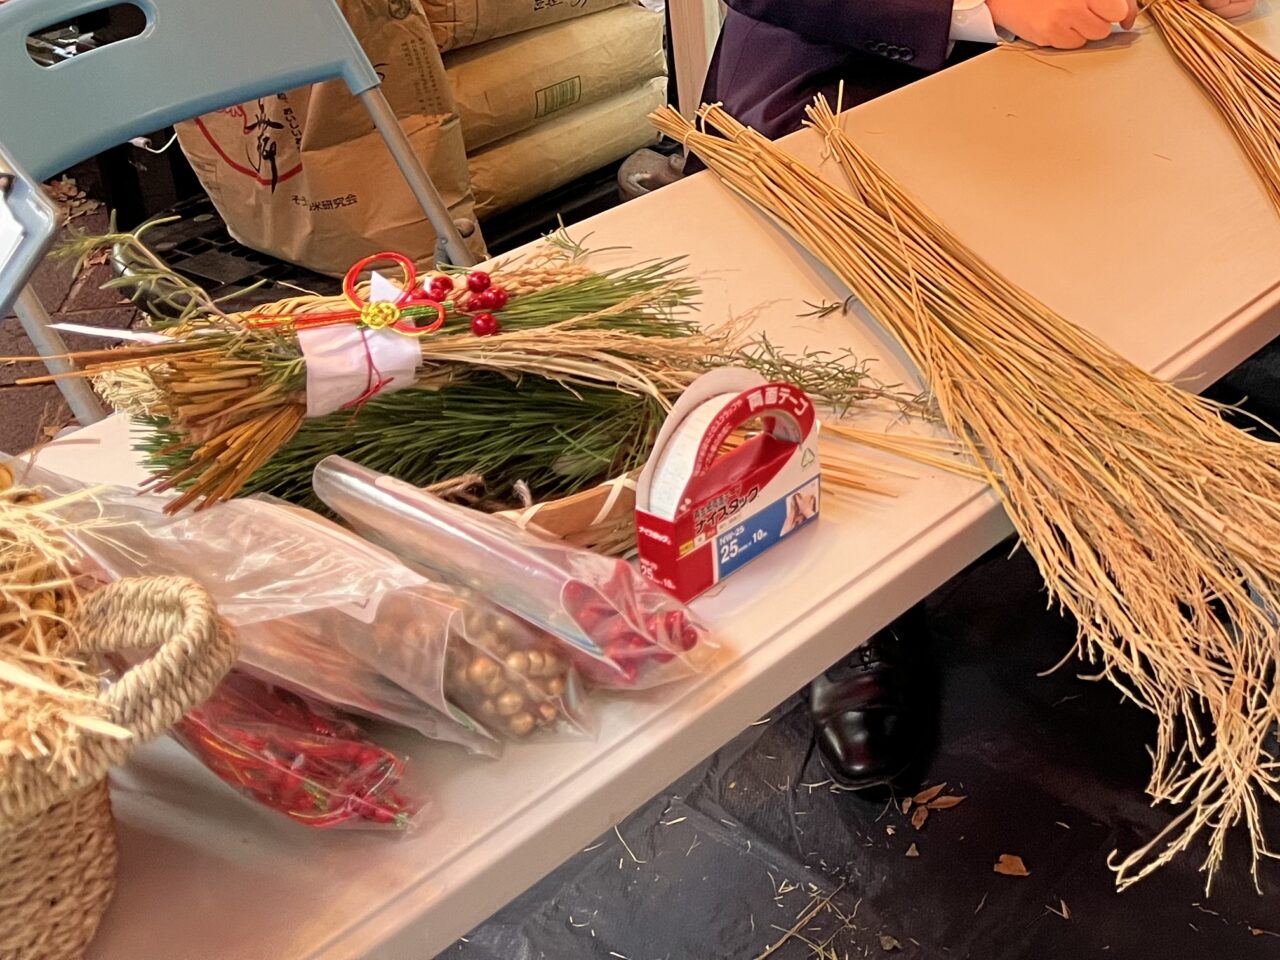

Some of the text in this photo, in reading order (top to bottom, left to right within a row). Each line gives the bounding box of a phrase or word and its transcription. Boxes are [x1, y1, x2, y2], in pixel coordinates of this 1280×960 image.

[695, 486, 758, 534] ナイスタック
